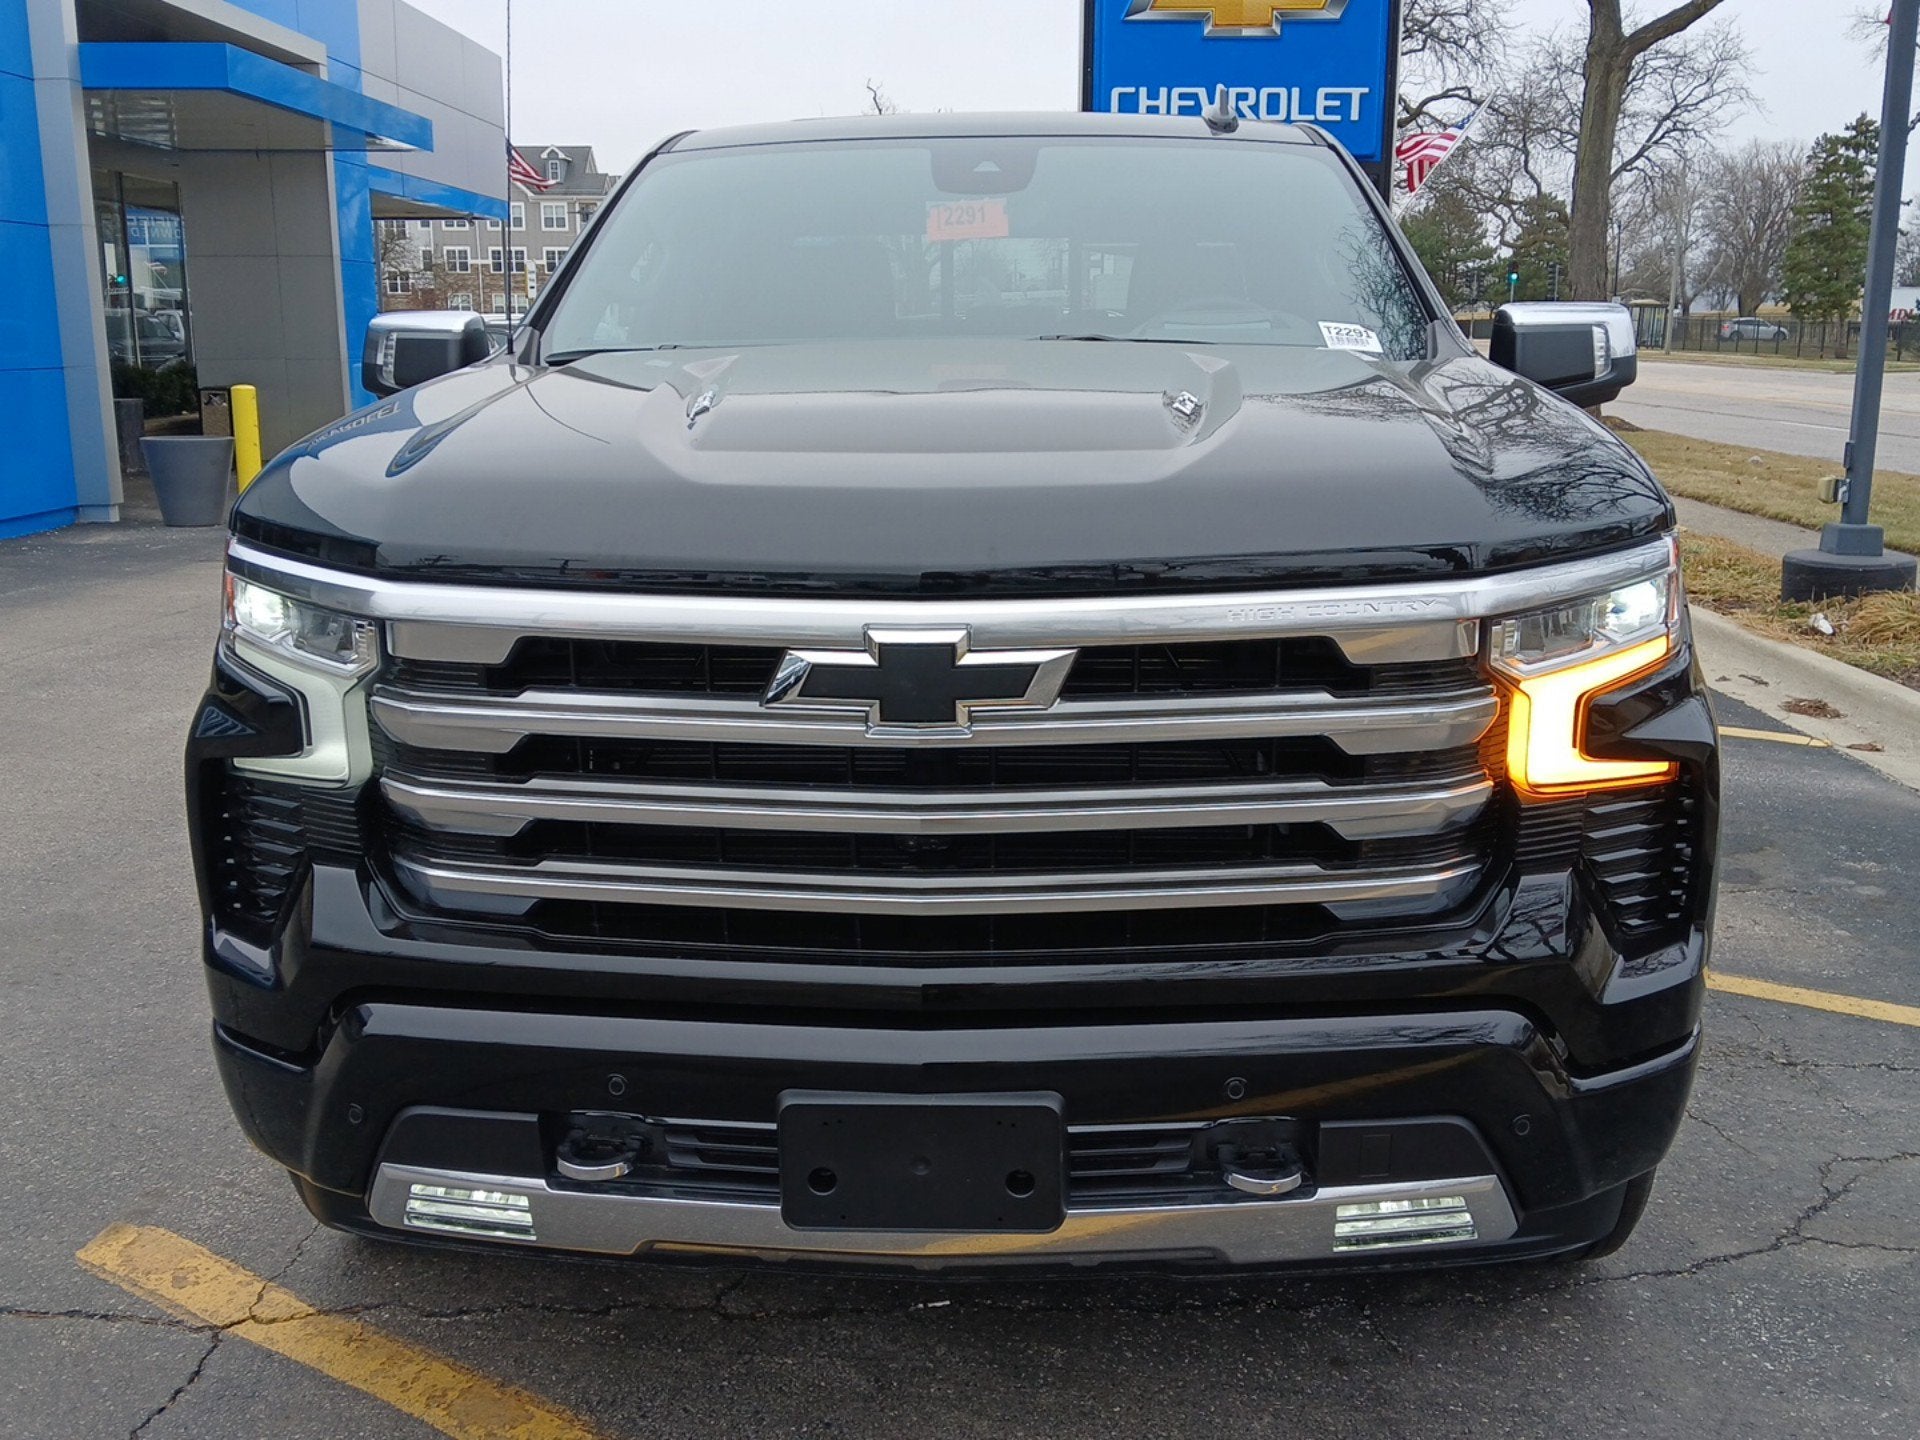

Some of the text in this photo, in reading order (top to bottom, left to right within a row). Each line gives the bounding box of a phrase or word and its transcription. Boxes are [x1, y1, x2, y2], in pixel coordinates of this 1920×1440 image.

[1111, 86, 1369, 121] CHEVROLET
[1322, 325, 1373, 339] T2291
[1227, 598, 1440, 622] HIGH COUNTRY
